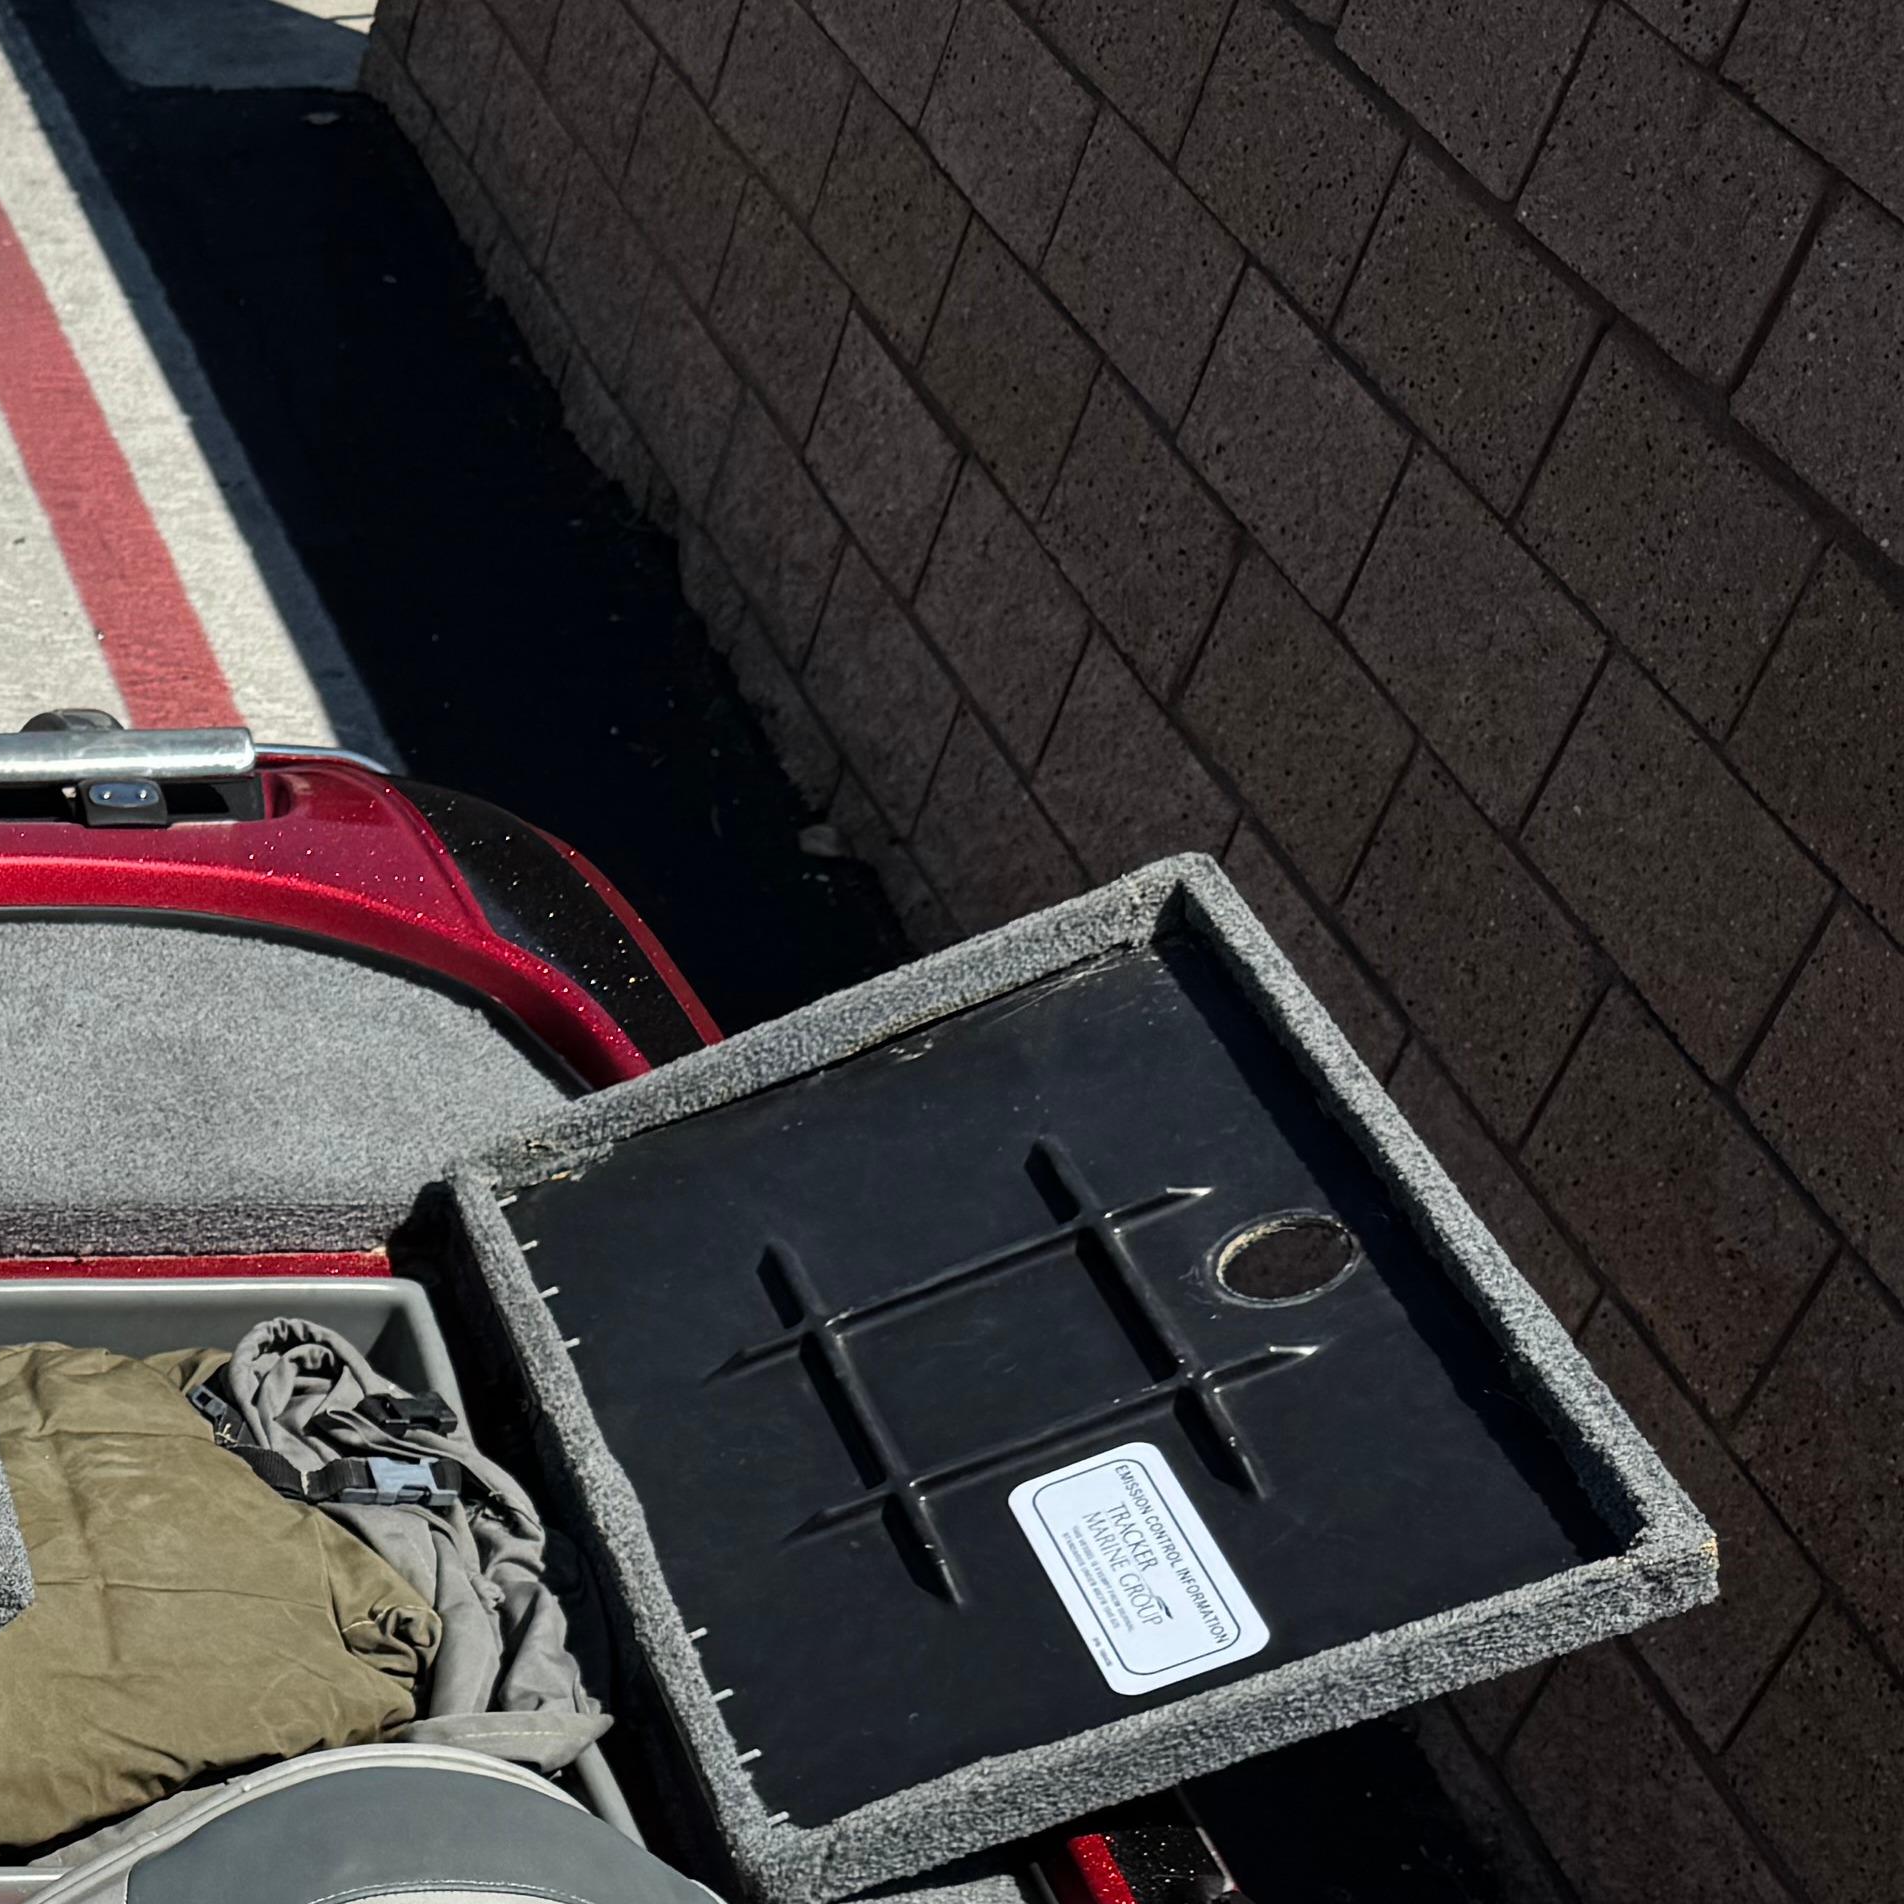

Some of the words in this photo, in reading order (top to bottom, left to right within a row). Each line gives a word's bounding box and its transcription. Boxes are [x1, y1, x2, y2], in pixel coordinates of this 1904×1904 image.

[1082, 1511, 1130, 1572] MARINE
[1119, 1573, 1163, 1625] GROUP
[1107, 1503, 1158, 1571] TRACKER
[1115, 1464, 1153, 1515] EMISSION
[1145, 1516, 1183, 1568] CONTROL
[1176, 1567, 1229, 1643] INFORMATION
